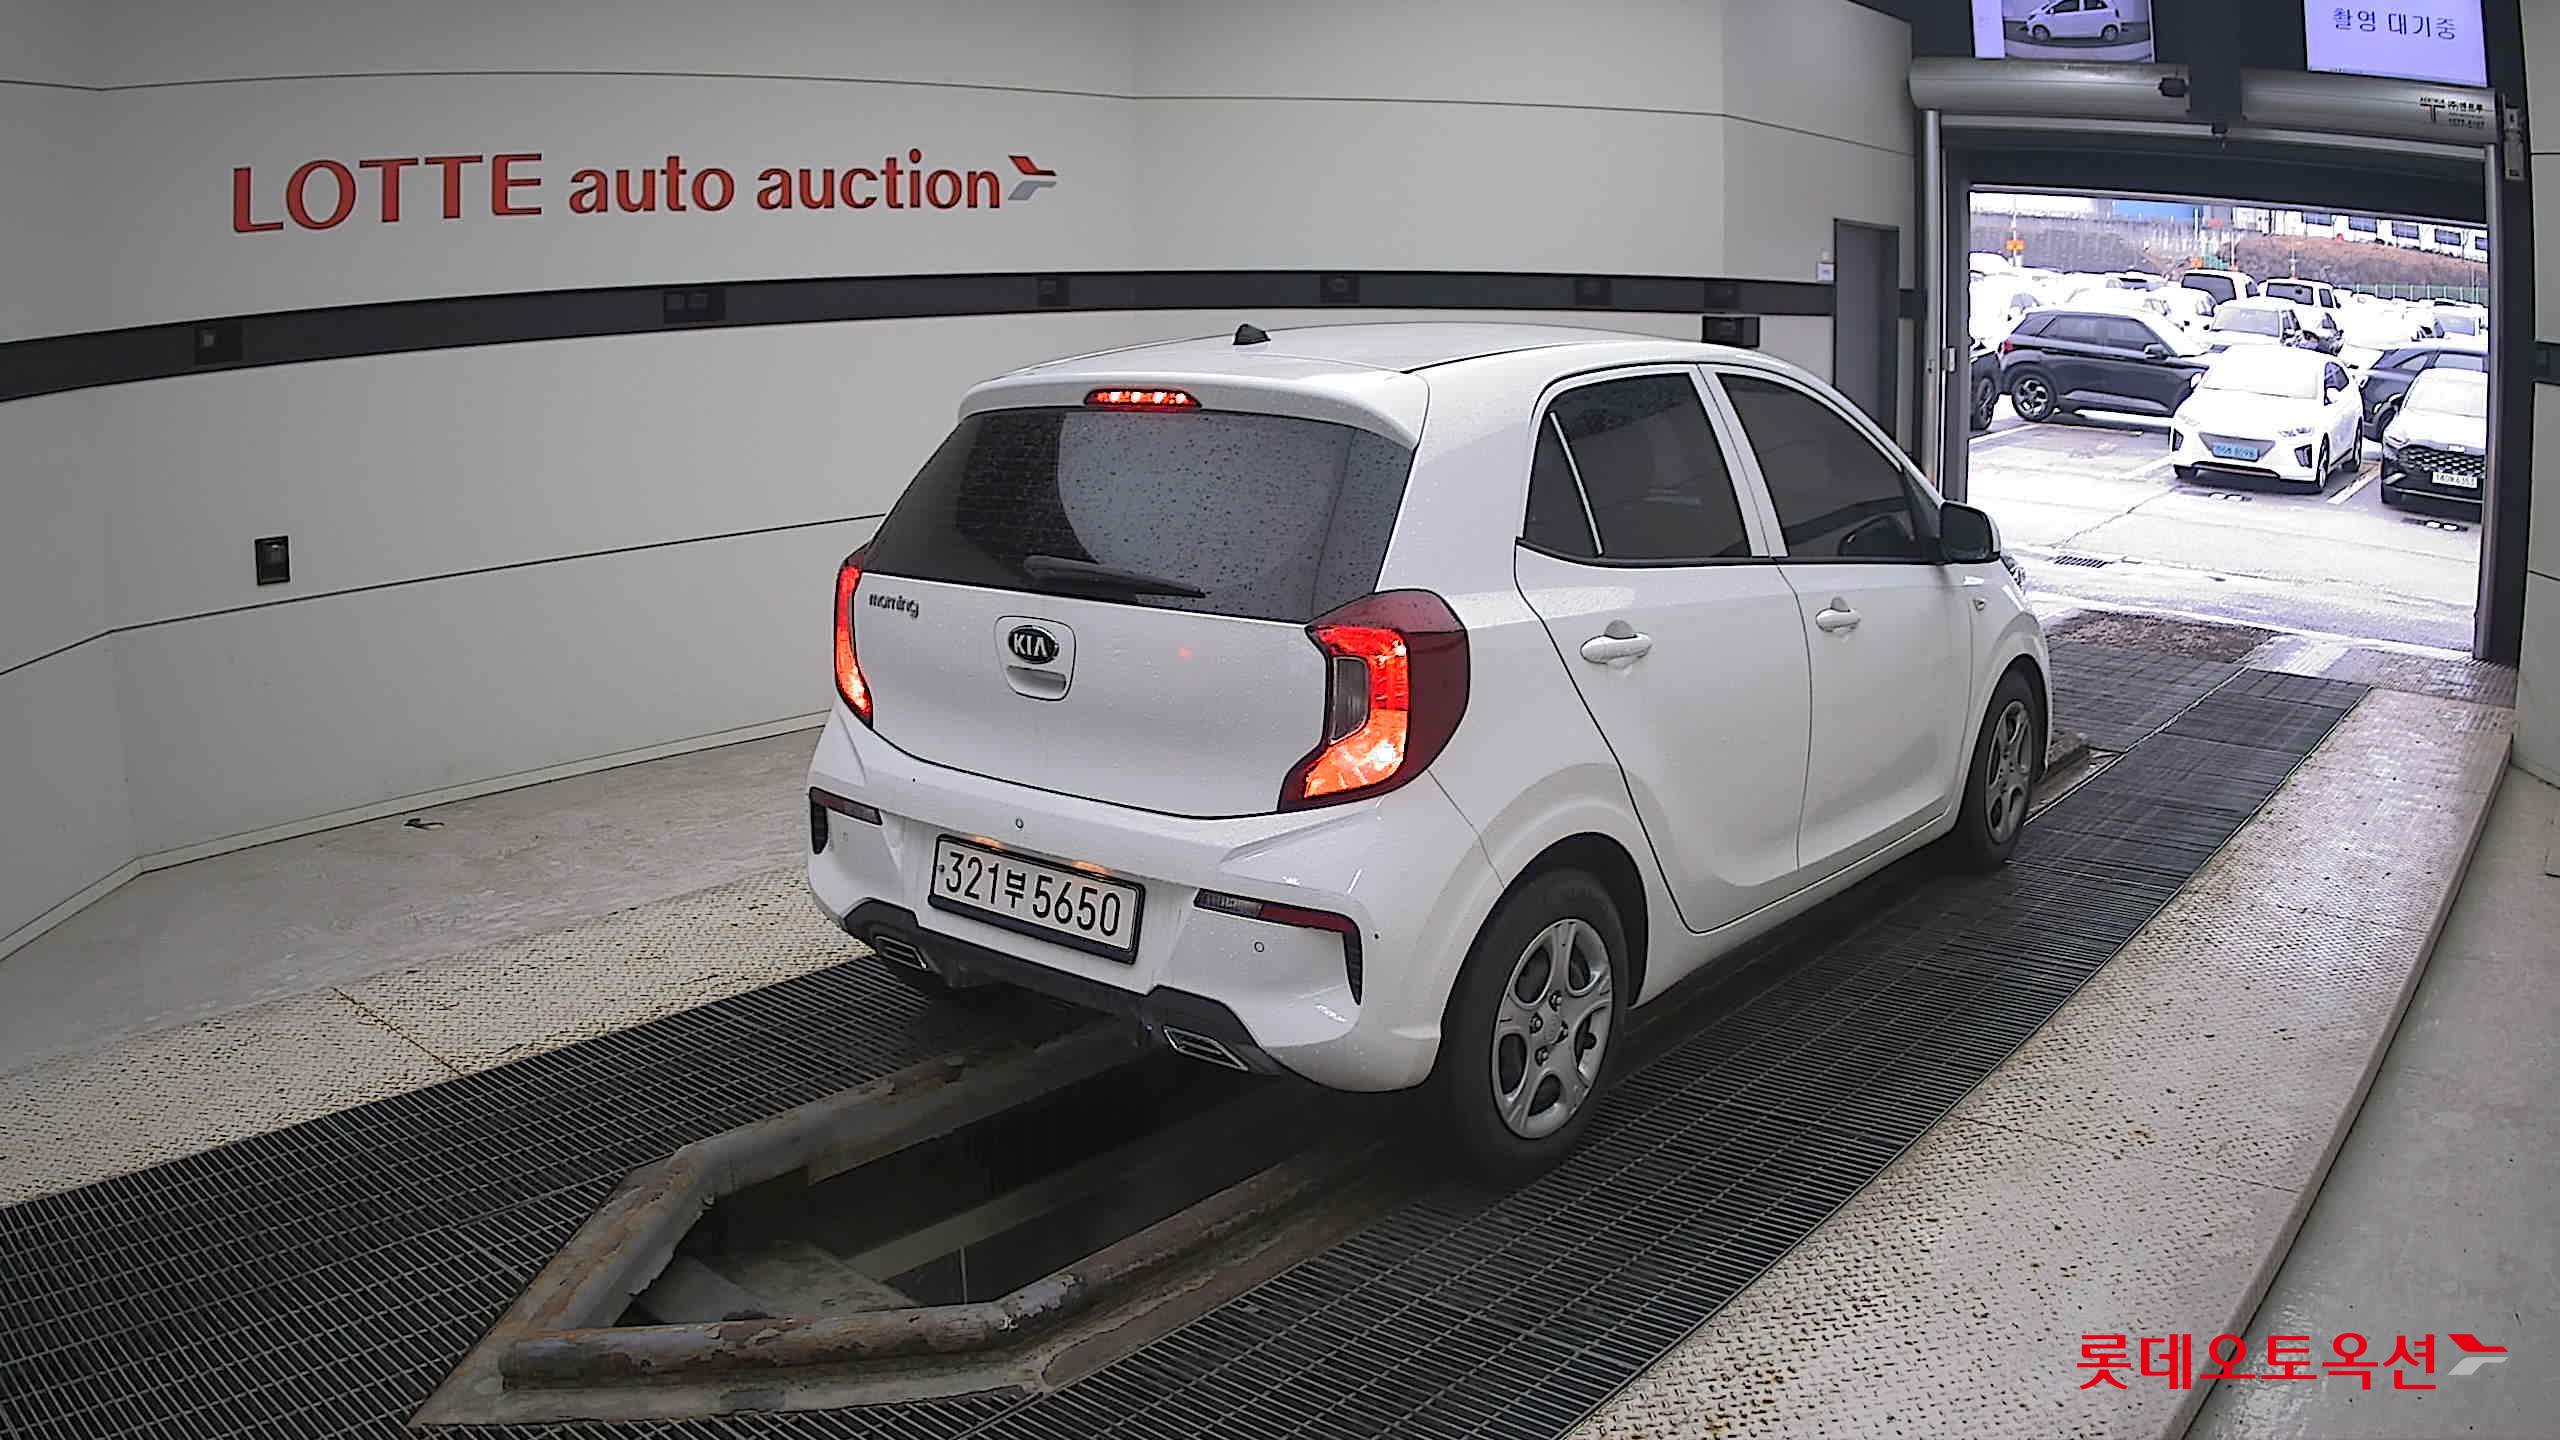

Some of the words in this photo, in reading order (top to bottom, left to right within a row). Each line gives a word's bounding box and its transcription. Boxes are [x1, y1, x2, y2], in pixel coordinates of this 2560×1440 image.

[2333, 7, 2376, 32] 촬영
[2388, 12, 2457, 40] 대기중
[232, 152, 544, 233] LOTTE
[568, 155, 736, 214] auto
[756, 147, 1002, 210] auction
[869, 593, 920, 619] morning
[1014, 633, 1048, 657] KIA
